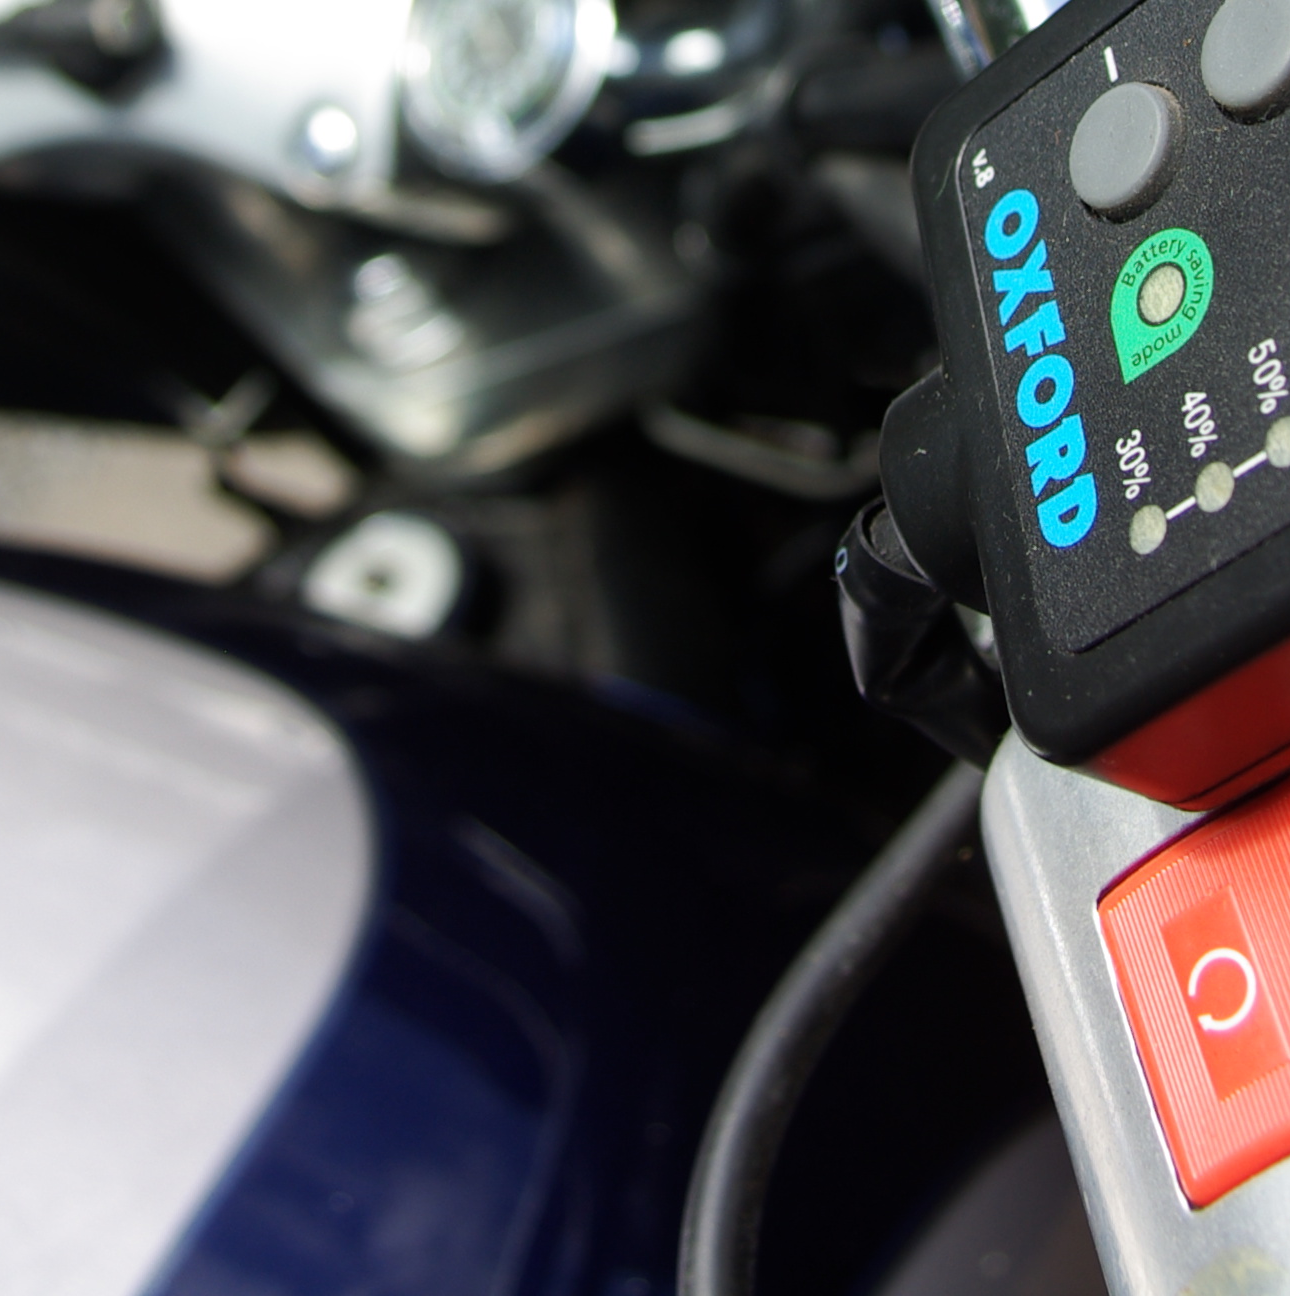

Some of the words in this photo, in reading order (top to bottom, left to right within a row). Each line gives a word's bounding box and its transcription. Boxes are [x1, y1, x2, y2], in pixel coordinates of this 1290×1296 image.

[972, 148, 995, 189] v.8
[1121, 239, 1187, 287] Battery
[1182, 248, 1210, 321] saving
[985, 189, 1099, 548] OXFORD
[1132, 323, 1182, 367] mode
[1248, 338, 1289, 414] 50%
[1181, 391, 1218, 458] 40%
[1115, 429, 1151, 499] 30%
